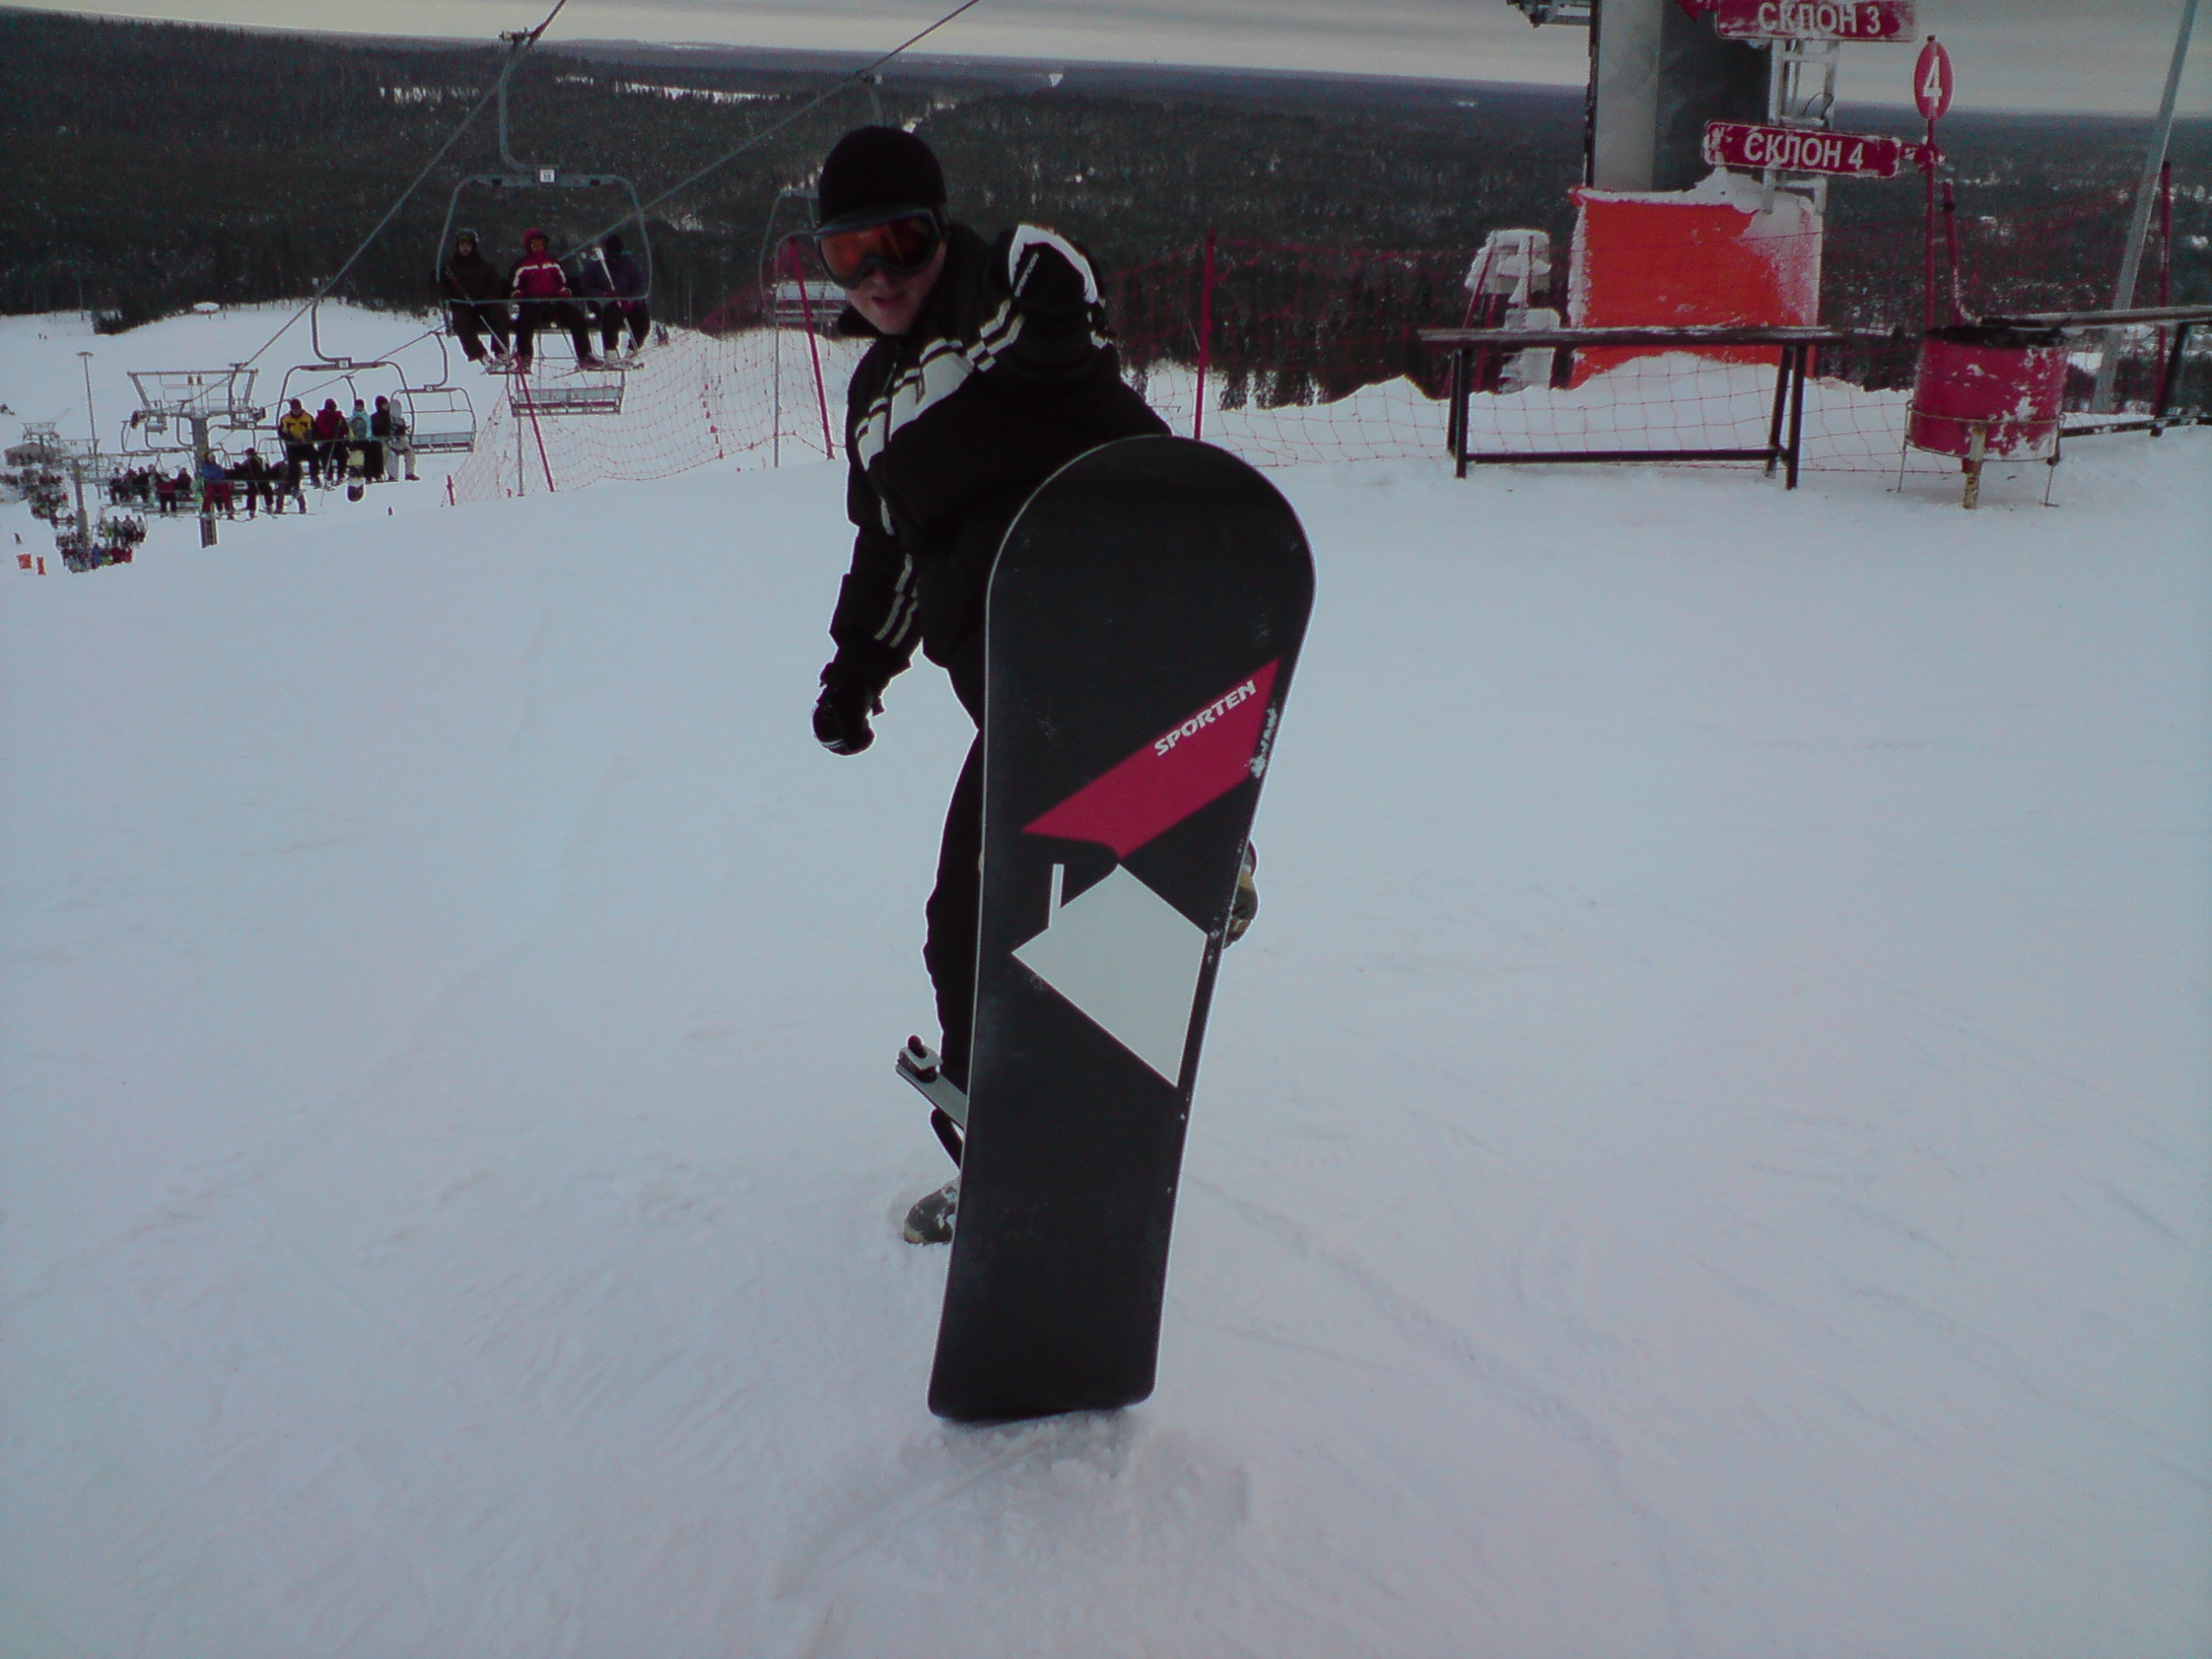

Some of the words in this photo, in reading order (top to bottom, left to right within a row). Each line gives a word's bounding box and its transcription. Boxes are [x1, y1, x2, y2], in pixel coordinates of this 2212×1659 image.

[1758, 2, 1857, 34] СКЛОН
[1866, 5, 1881, 35] 3
[1923, 55, 1943, 107] 4
[1744, 131, 1842, 168] СКЛОН
[1848, 142, 1864, 170] 4
[1154, 679, 1257, 757] SPORTEN
